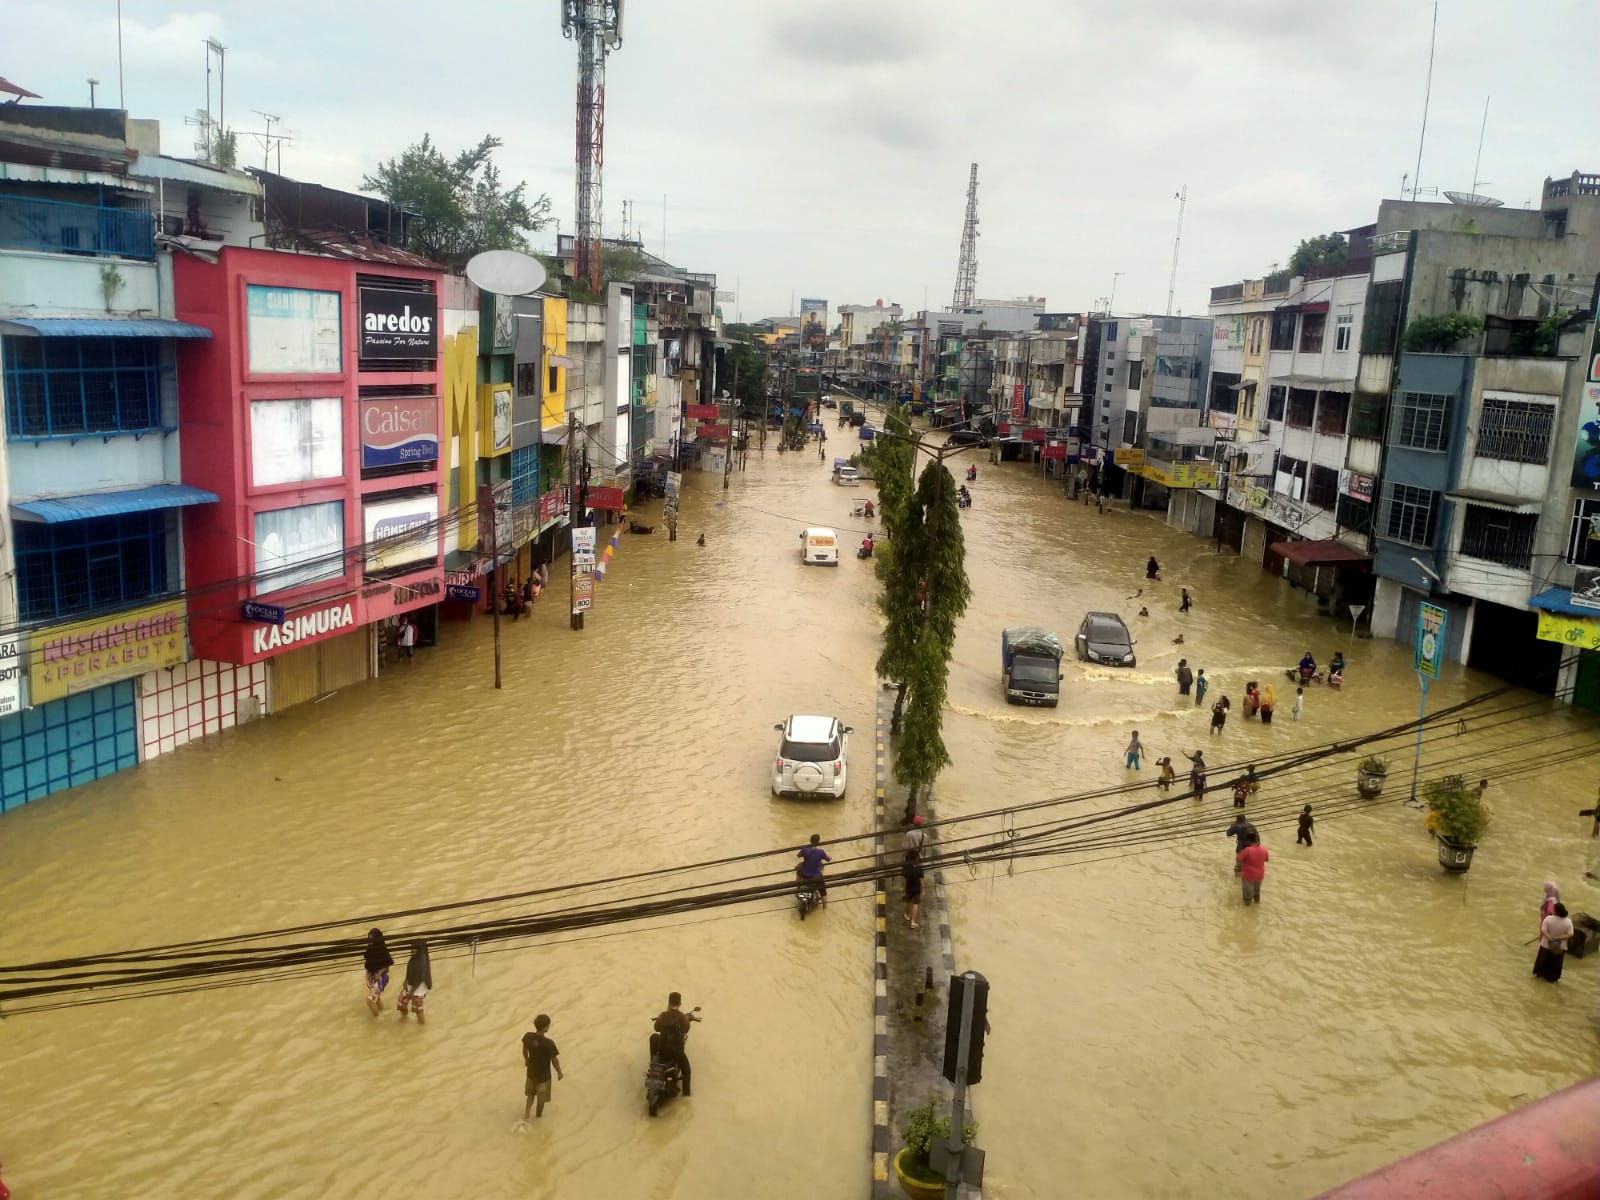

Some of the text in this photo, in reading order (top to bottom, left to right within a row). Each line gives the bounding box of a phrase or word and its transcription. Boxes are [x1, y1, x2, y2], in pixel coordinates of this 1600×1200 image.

[365, 305, 431, 333] aredos
[365, 336, 430, 347] Passion For Nature
[365, 405, 431, 435] Caisar
[400, 444, 434, 460] Spring Bed
[44, 610, 177, 665] NUSANTARA
[254, 603, 354, 654] KASIMURA
[57, 640, 162, 682] PERABOT
